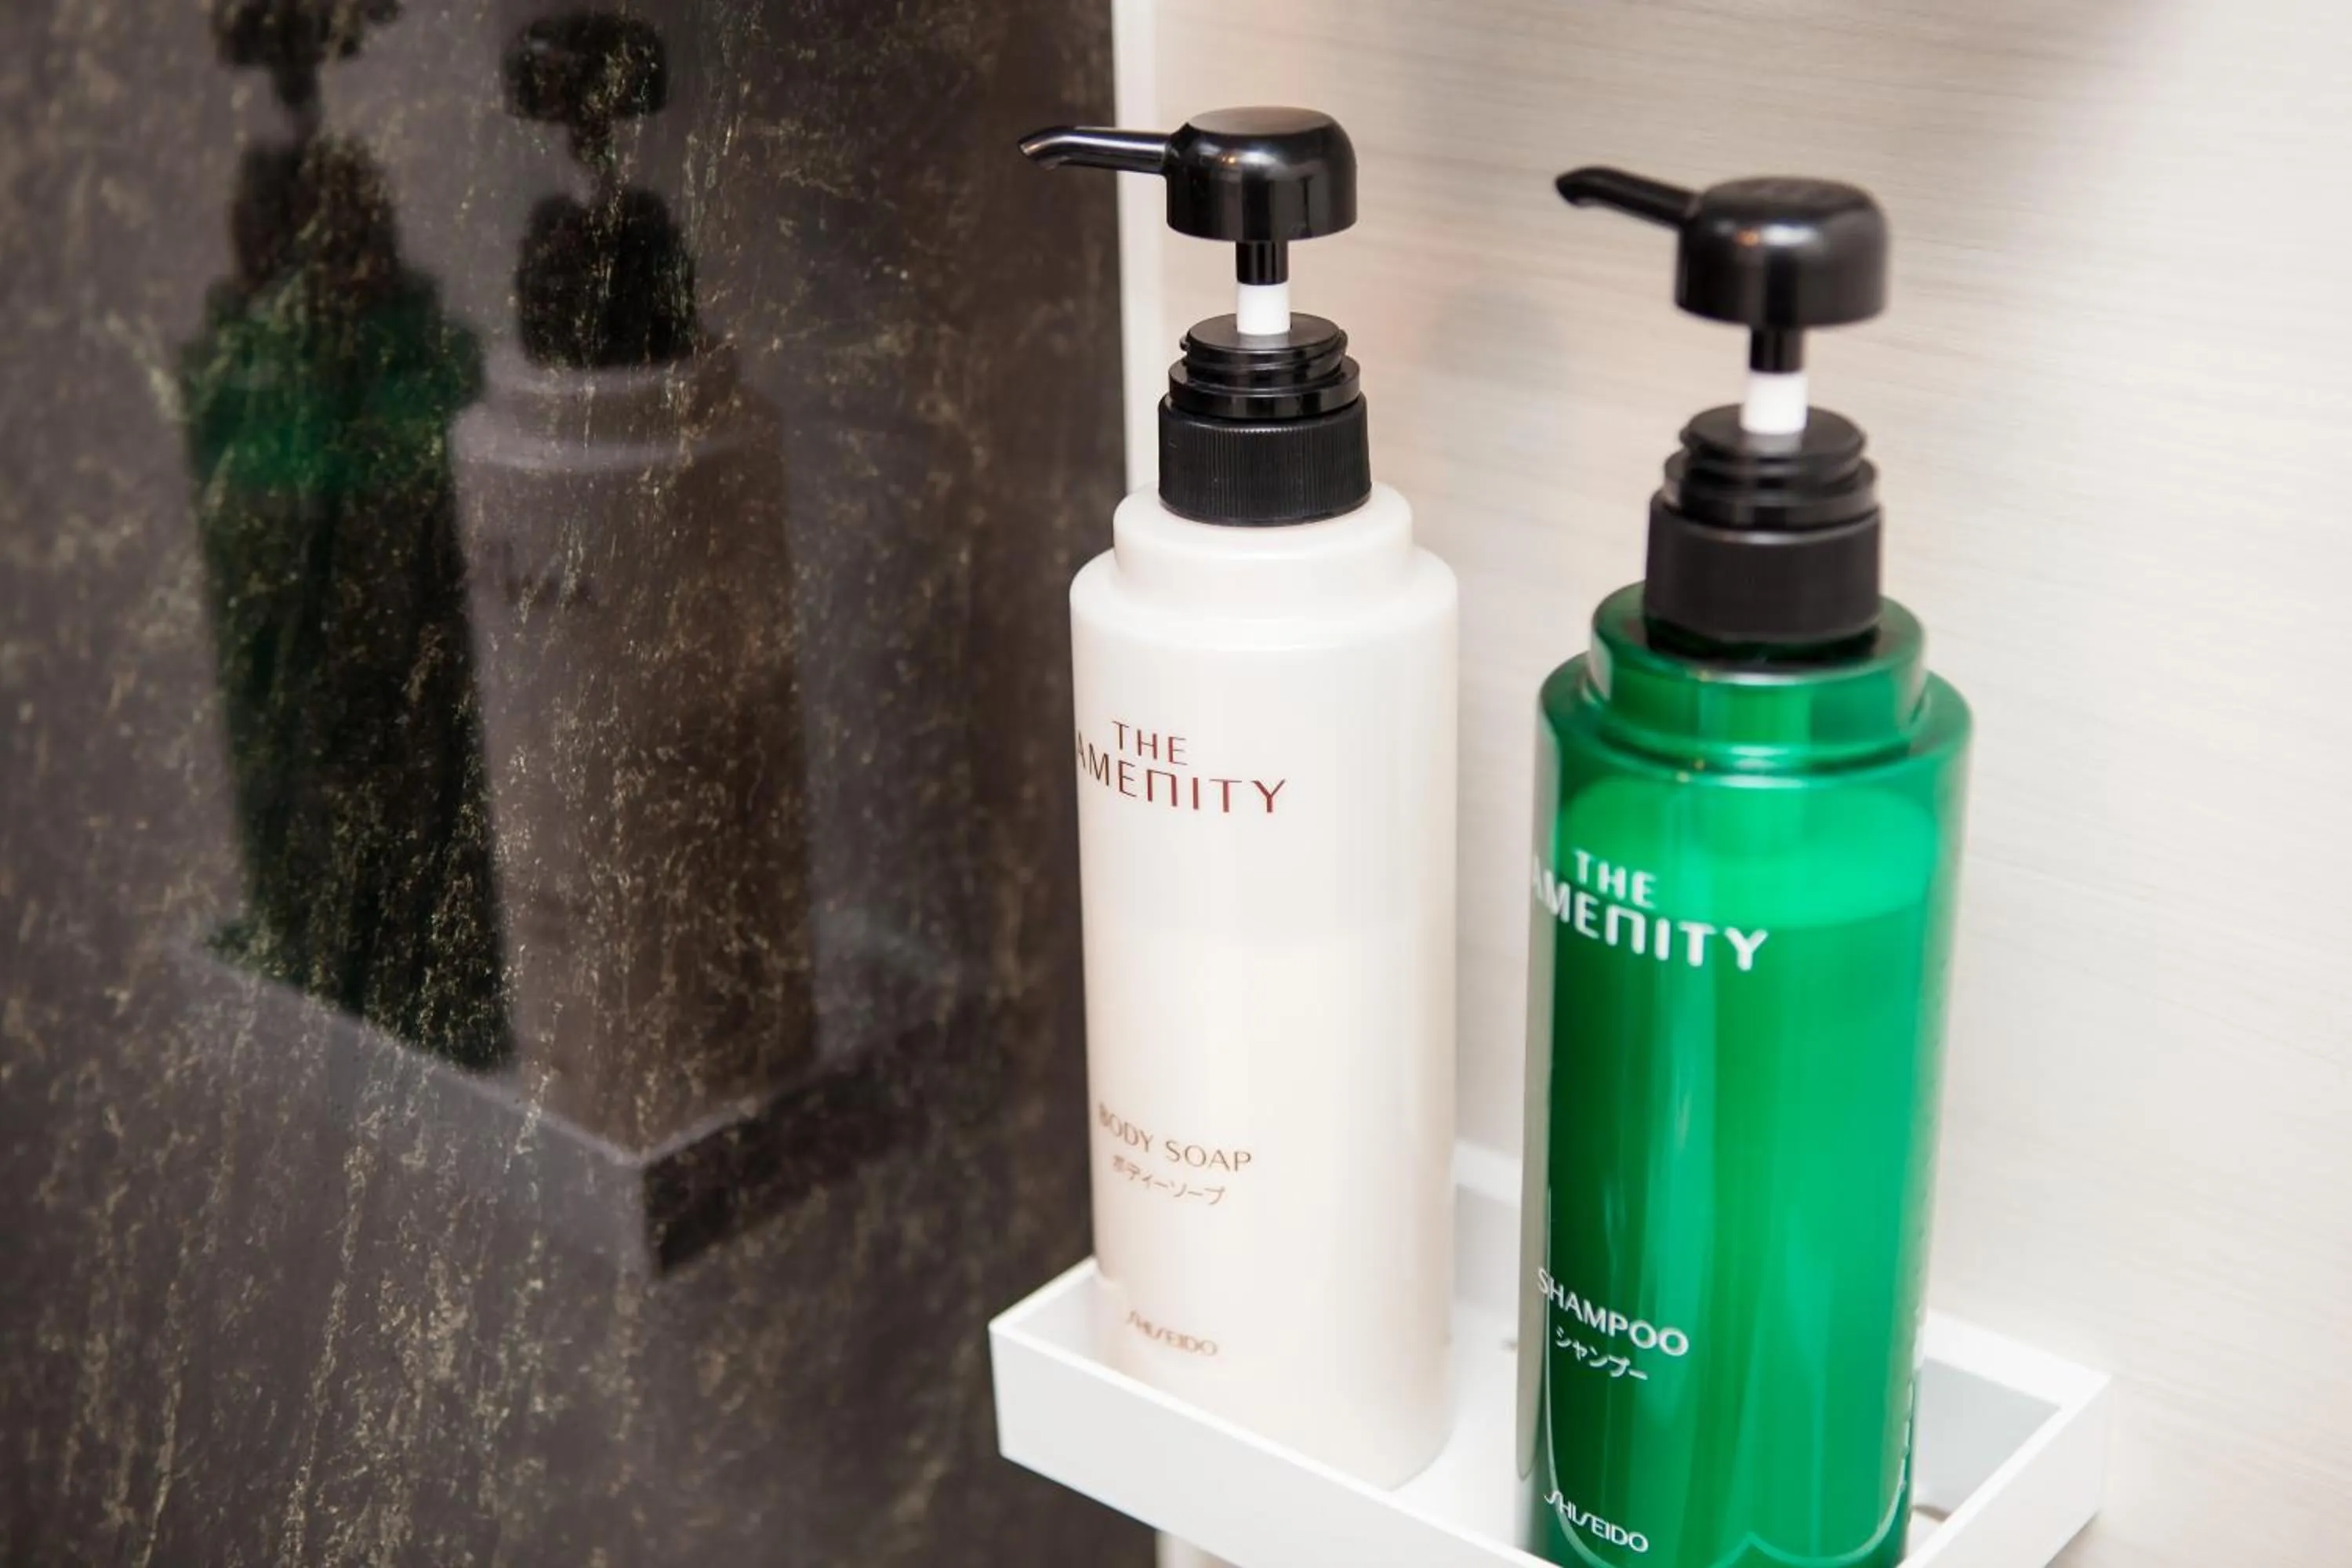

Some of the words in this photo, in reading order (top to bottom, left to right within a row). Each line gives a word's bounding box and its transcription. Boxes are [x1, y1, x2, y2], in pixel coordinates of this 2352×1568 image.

[1076, 730, 1286, 813] AMENITY
[1112, 720, 1189, 765] THE
[1572, 848, 1657, 910] THE
[1531, 855, 1769, 971] AMENITY
[1165, 1139, 1252, 1172] SOAP
[1125, 1310, 1218, 1356] SHISEIDO
[1538, 1267, 1690, 1356] SHAMPOO
[1543, 1490, 1649, 1552] SHISEIDO
